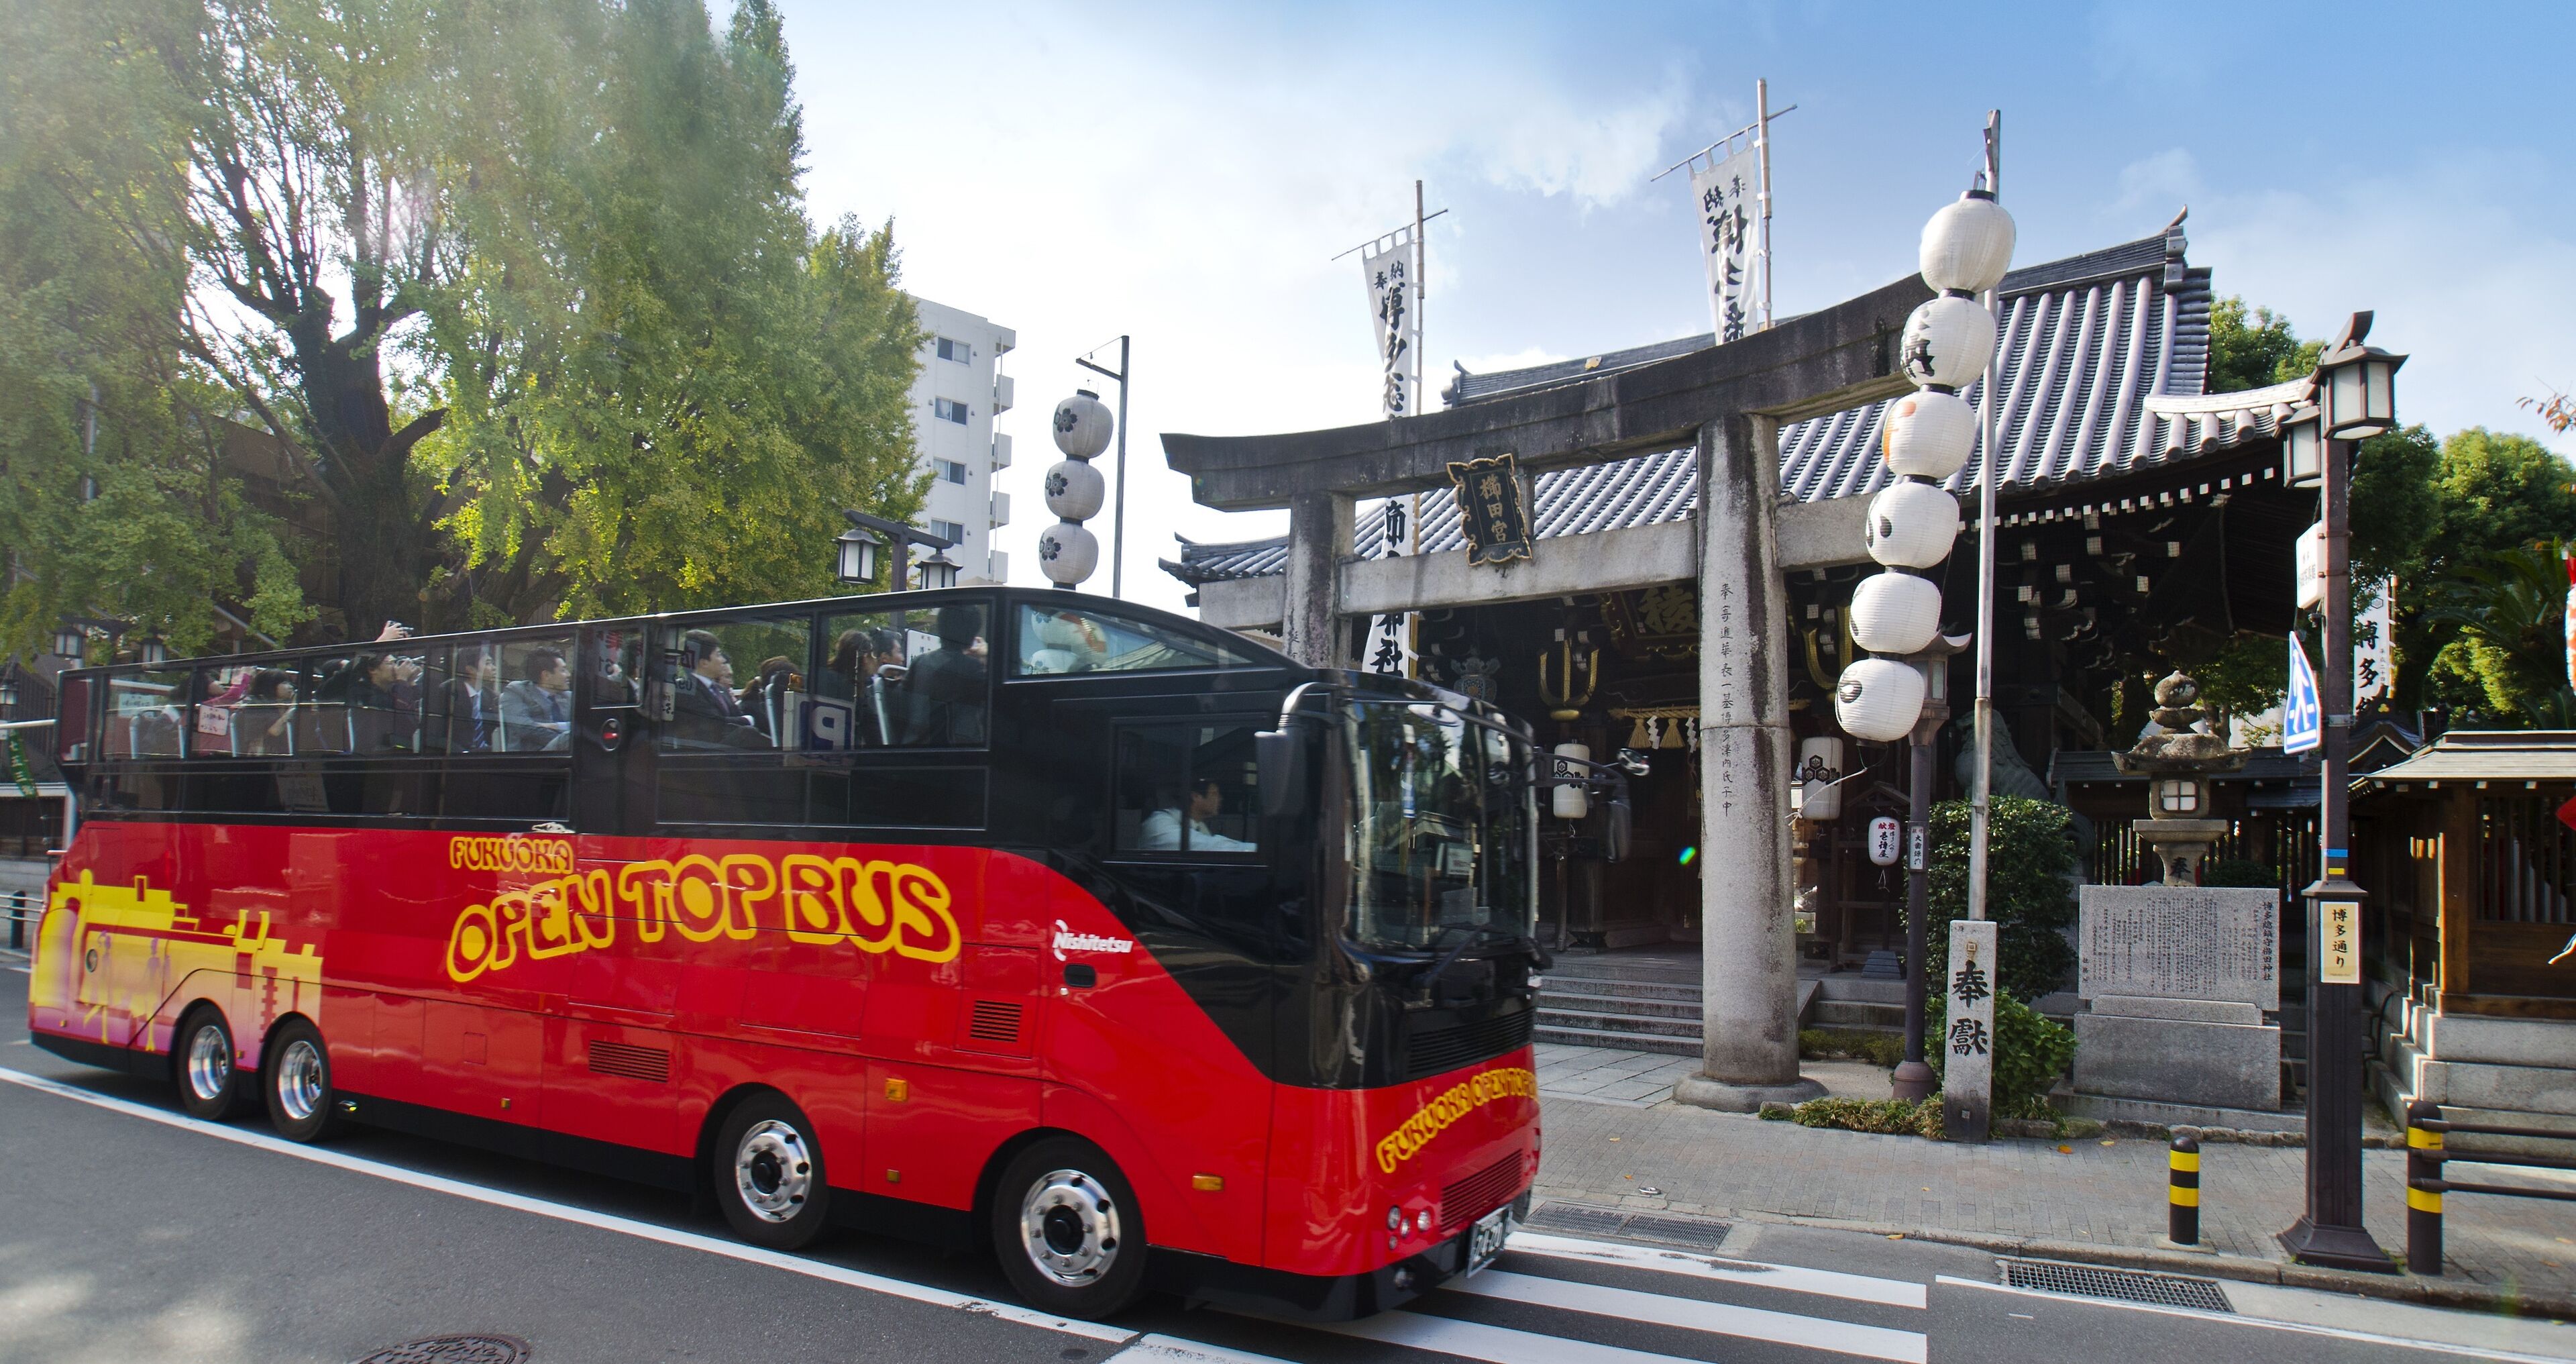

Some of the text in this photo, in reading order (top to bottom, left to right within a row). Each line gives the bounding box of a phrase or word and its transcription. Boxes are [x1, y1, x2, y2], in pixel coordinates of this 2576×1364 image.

[1374, 260, 1404, 290] 奉納
[1479, 473, 1508, 542] 櫛田宮
[449, 837, 574, 874] FUKUOKA
[2169, 856, 2191, 878] 奉
[445, 853, 962, 982] OPEN TOP BUS
[1052, 929, 1134, 953] Nishitetsu
[2332, 908, 2347, 968] 博多通り
[1376, 1082, 1473, 1174] FUKUOKA
[1470, 1068, 1509, 1107] OPEN
